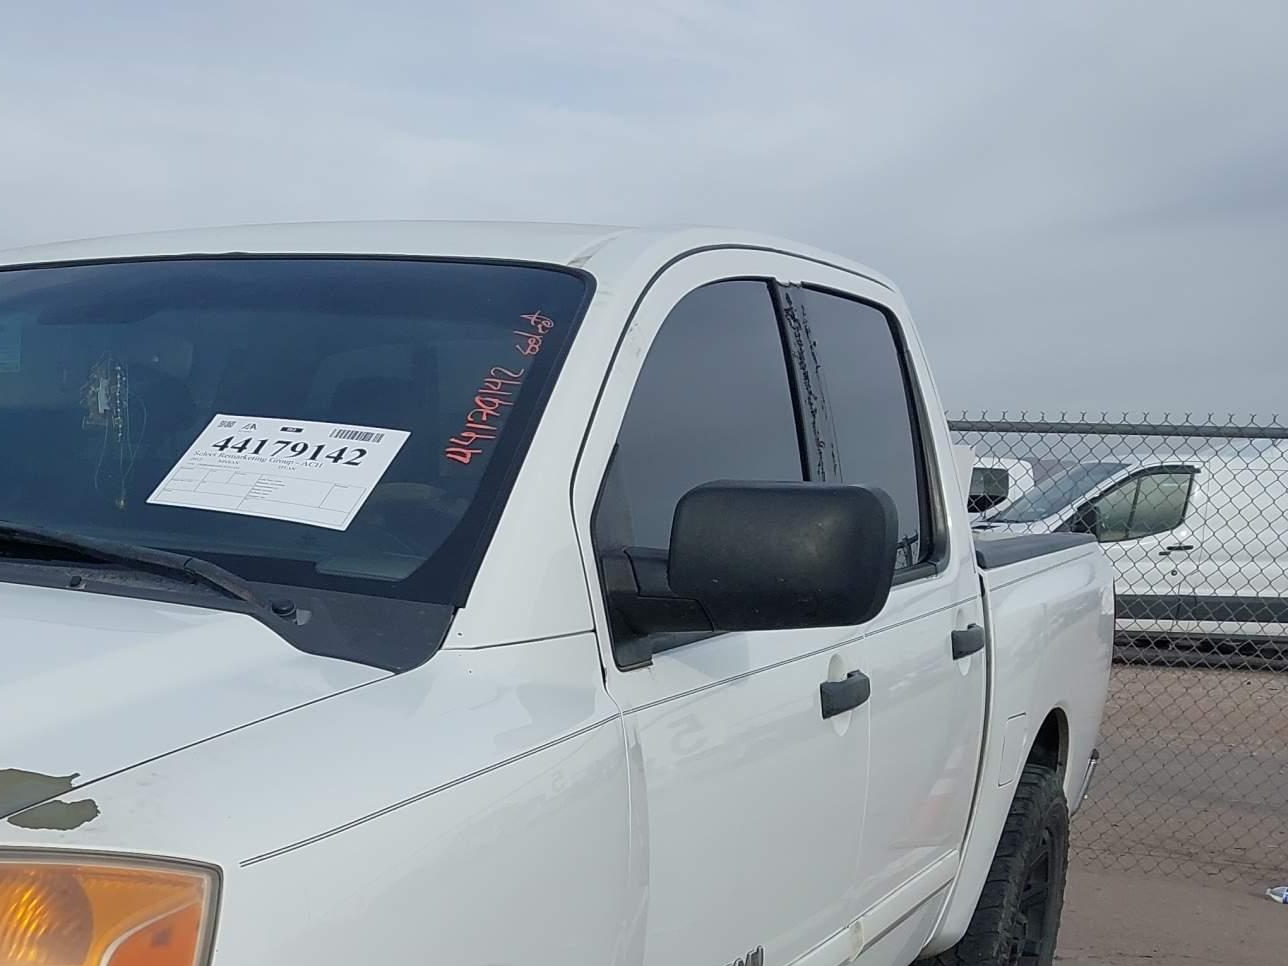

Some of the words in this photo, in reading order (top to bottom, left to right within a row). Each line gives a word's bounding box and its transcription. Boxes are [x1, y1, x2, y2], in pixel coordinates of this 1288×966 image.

[445, 366, 525, 465] 44179142
[212, 435, 368, 467] 44179142
[218, 452, 268, 464] Remarketing
